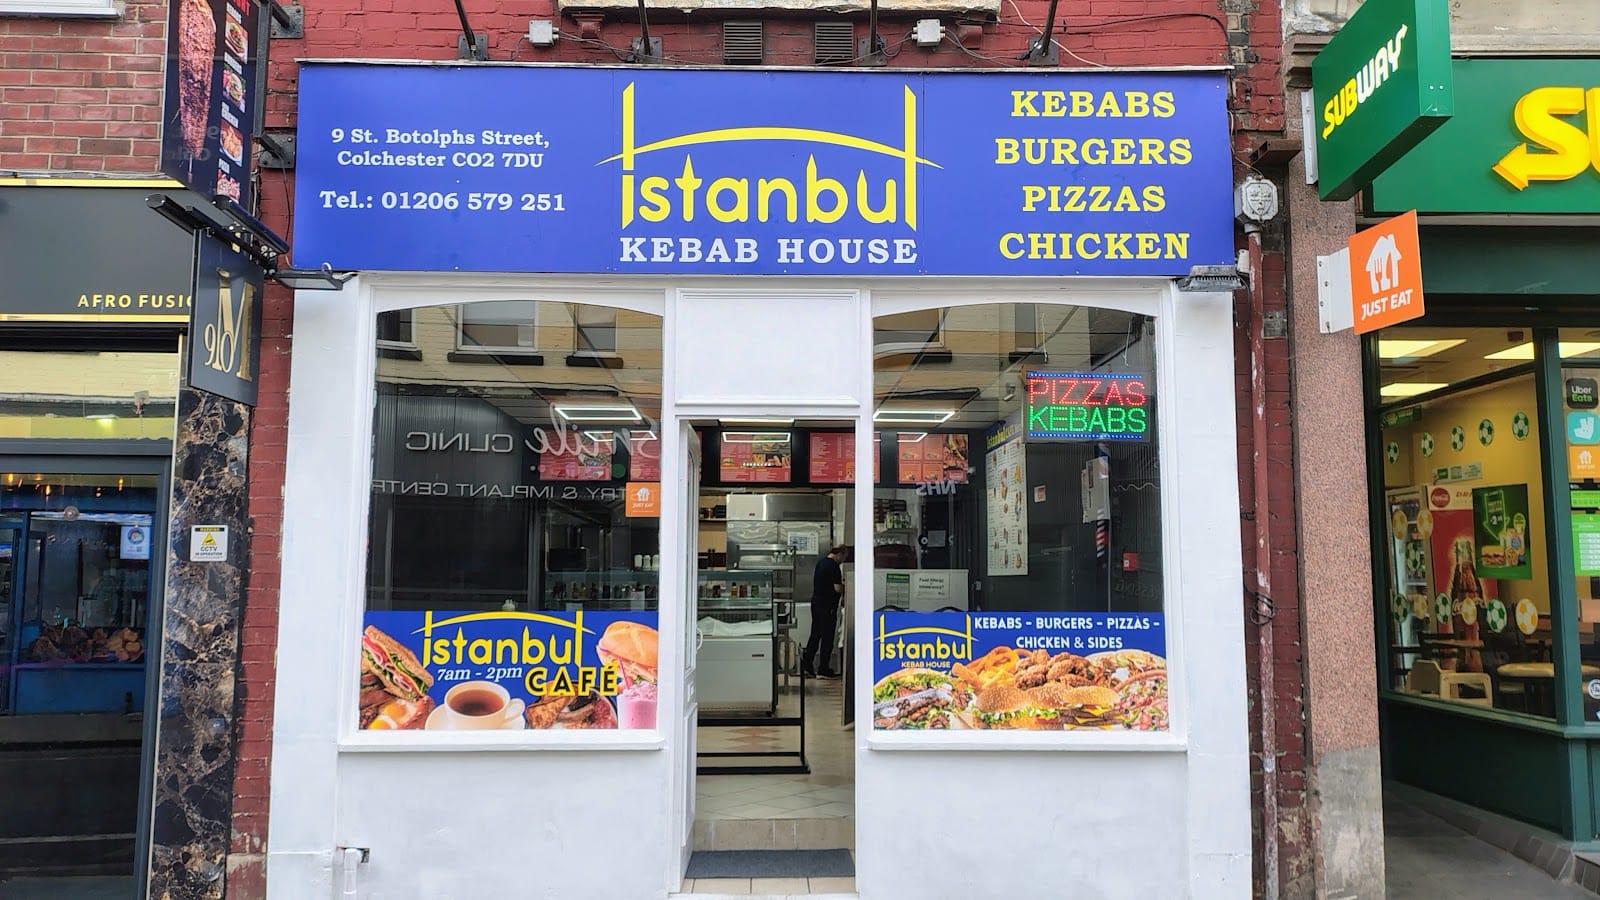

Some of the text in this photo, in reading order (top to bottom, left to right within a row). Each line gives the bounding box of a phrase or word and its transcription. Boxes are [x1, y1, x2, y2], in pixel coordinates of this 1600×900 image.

[1322, 23, 1408, 141] SUBWAY
[1010, 90, 1176, 118] KEBABS
[331, 129, 550, 148] 9 St. Botolphs Street,
[994, 137, 1193, 165] BURGERS
[1491, 86, 1600, 192] S
[337, 150, 544, 168] Colchester CO2 7DU
[320, 190, 566, 211] Tel.: 01206 579 251
[1022, 185, 1166, 213] PIZZAS
[620, 236, 917, 264] KEBAB HOUSE
[998, 232, 1190, 260] CHICKEN
[77, 294, 191, 308] AFRO FUSI
[1361, 288, 1413, 321] JUST EAT
[1029, 378, 1146, 406] PIZZAS
[1571, 385, 1592, 394] Uber
[1572, 393, 1593, 402] Eats
[1029, 405, 1147, 433] KEBABS
[974, 617, 1022, 630] KEBABS
[1036, 617, 1093, 630] BURGERS
[1107, 617, 1150, 630] PIZZAS
[1016, 636, 1123, 649] CHICKEN & SIDES
[437, 667, 471, 682] 7am
[486, 667, 522, 683] 2pm
[525, 661, 619, 697] CAFÉ
